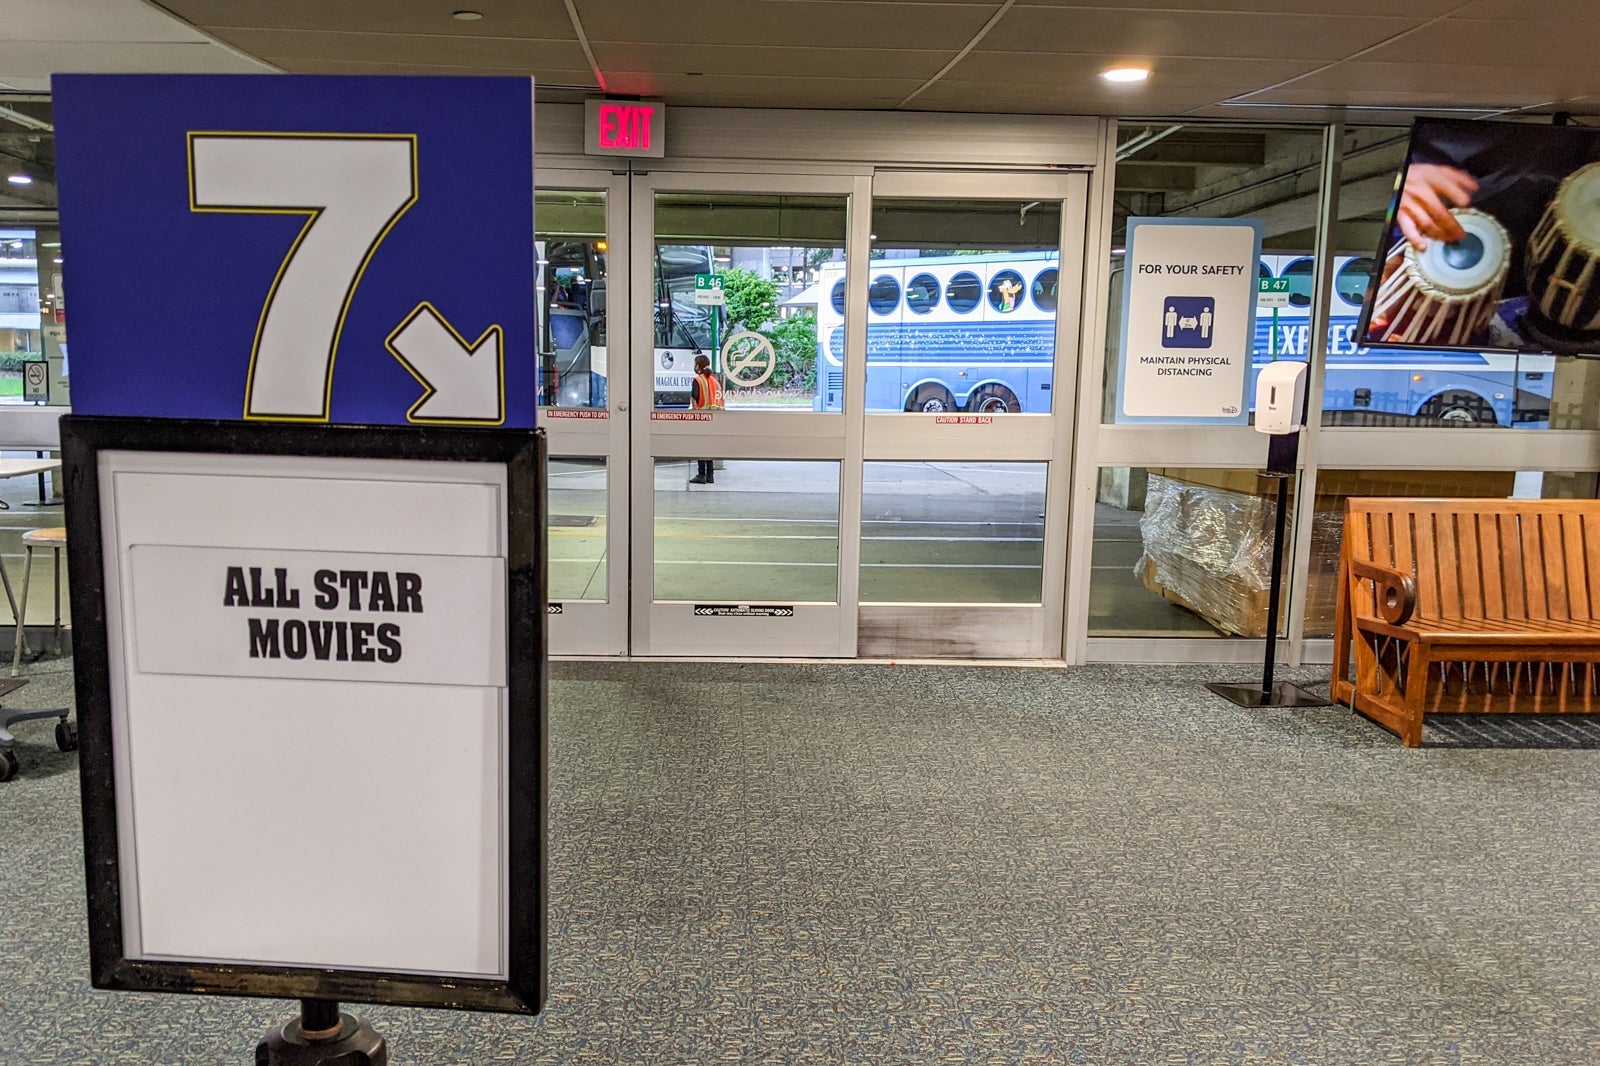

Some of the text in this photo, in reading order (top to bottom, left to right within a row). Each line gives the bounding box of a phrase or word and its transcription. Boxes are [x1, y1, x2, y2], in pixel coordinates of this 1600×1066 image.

[599, 104, 654, 150] EXIT
[1138, 264, 1245, 275] FOR YOUR SAFETY
[187, 131, 418, 423] 7
[698, 277, 722, 287] B 46
[1261, 280, 1287, 290] B 47
[1140, 356, 1231, 366] MAINTAIN PHYSICAL
[1157, 368, 1212, 376] DISTANCING
[656, 376, 679, 387] MAGICAL
[937, 416, 991, 424] CAUTION STAND BACK
[223, 566, 424, 613] ALL STAR
[248, 618, 402, 663] MOVIES
